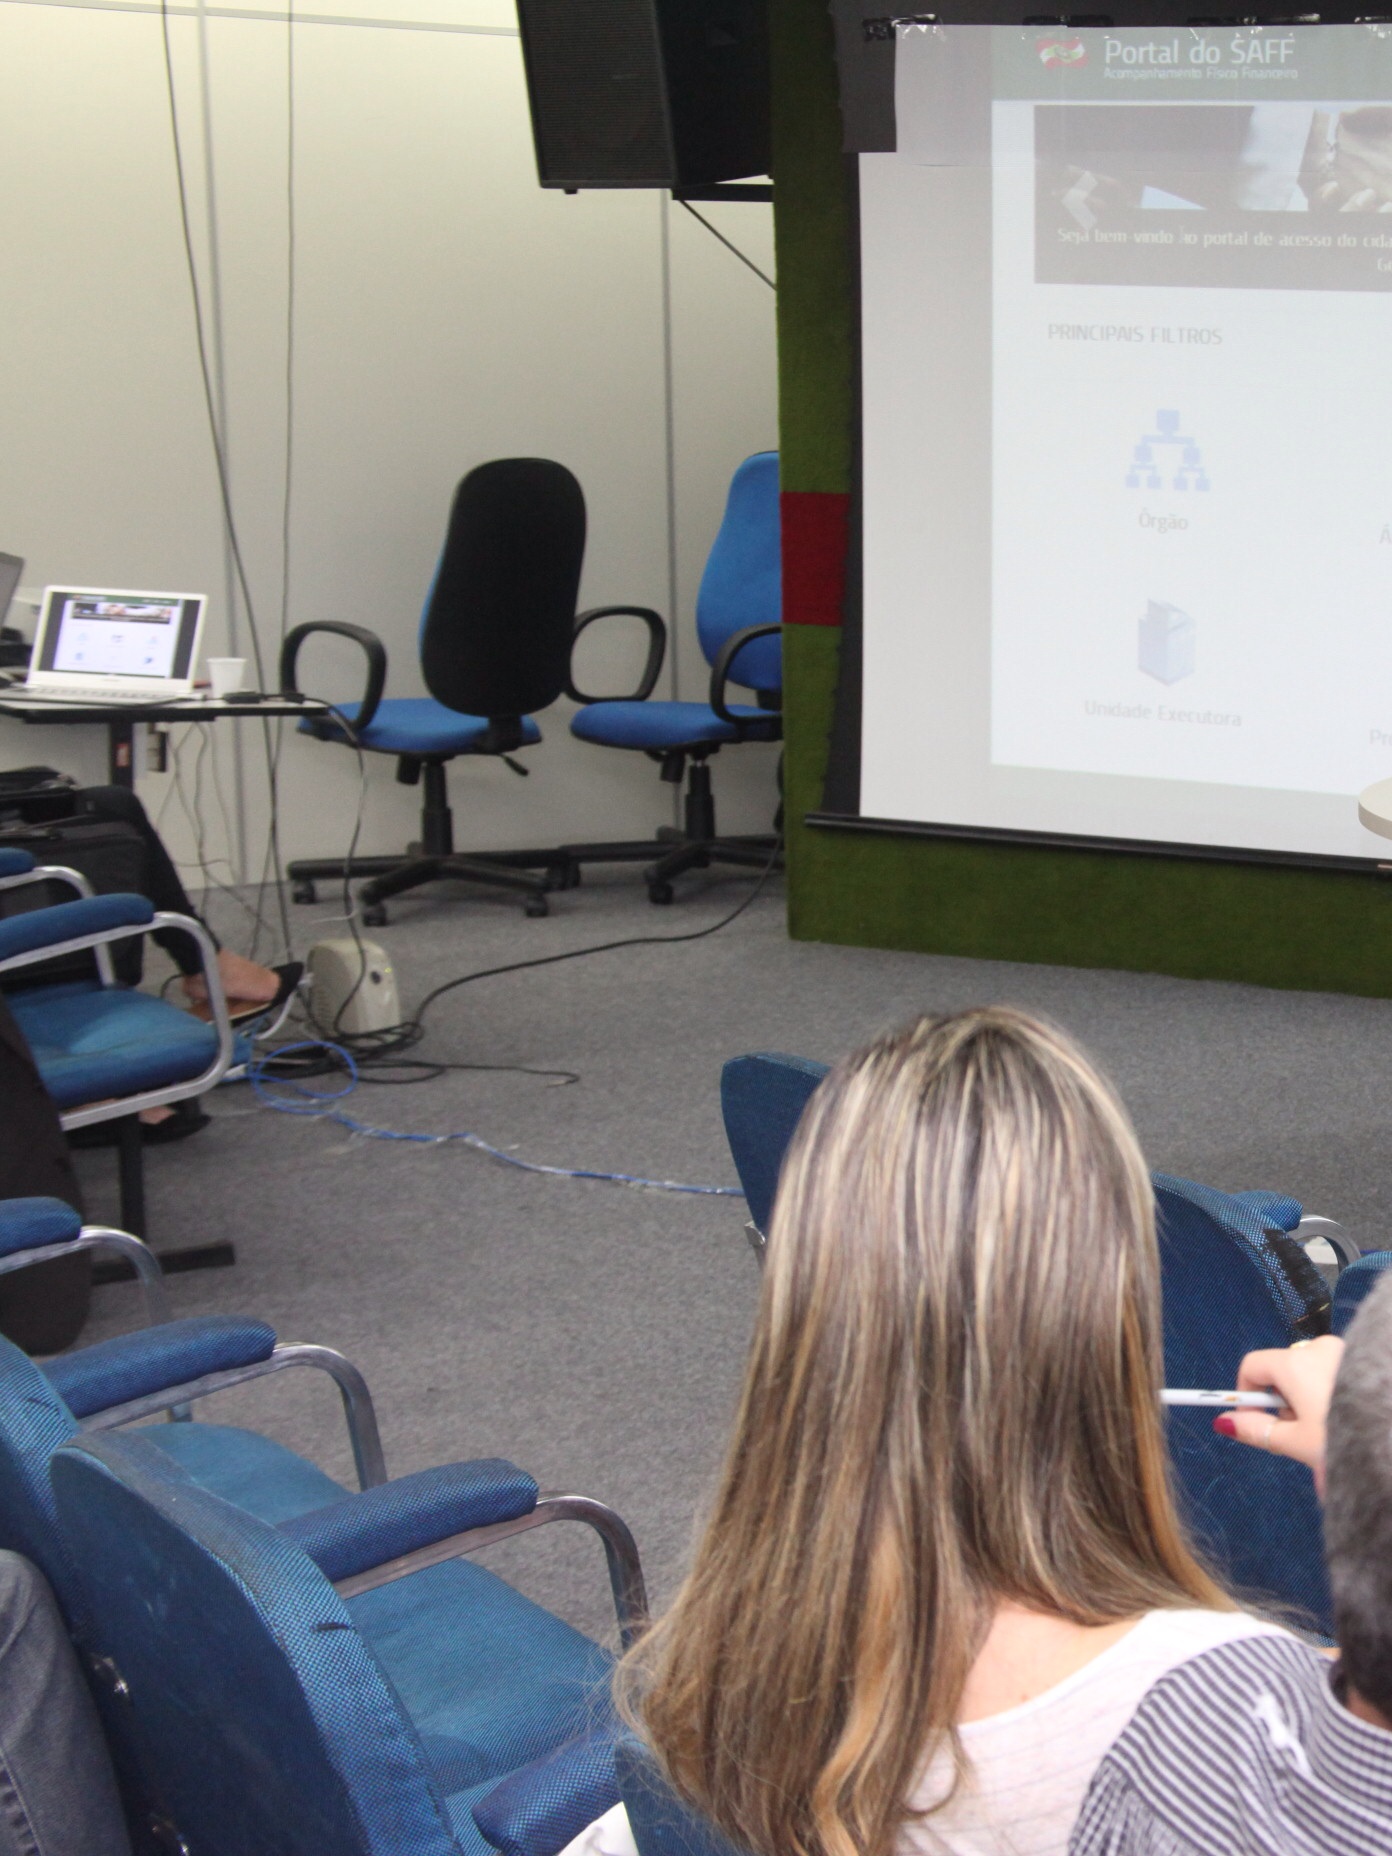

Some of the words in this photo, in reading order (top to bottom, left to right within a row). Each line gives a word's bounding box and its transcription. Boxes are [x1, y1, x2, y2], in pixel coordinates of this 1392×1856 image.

[1104, 38, 1179, 64] Portal
[1189, 38, 1220, 64] do
[1230, 38, 1296, 64] SAFF
[1104, 66, 1202, 81] Acompanhamento
[1242, 66, 1298, 80] Financeiro
[1056, 226, 1090, 246] Seja
[1203, 231, 1248, 249] portal
[1253, 231, 1274, 247] de
[1279, 233, 1332, 247] acesso
[1337, 233, 1357, 248] do
[1047, 322, 1145, 343] PRINCIPAIS
[1150, 325, 1223, 346] FILTROS
[1083, 699, 1153, 720] Unidade
[1157, 705, 1243, 728] Executora
